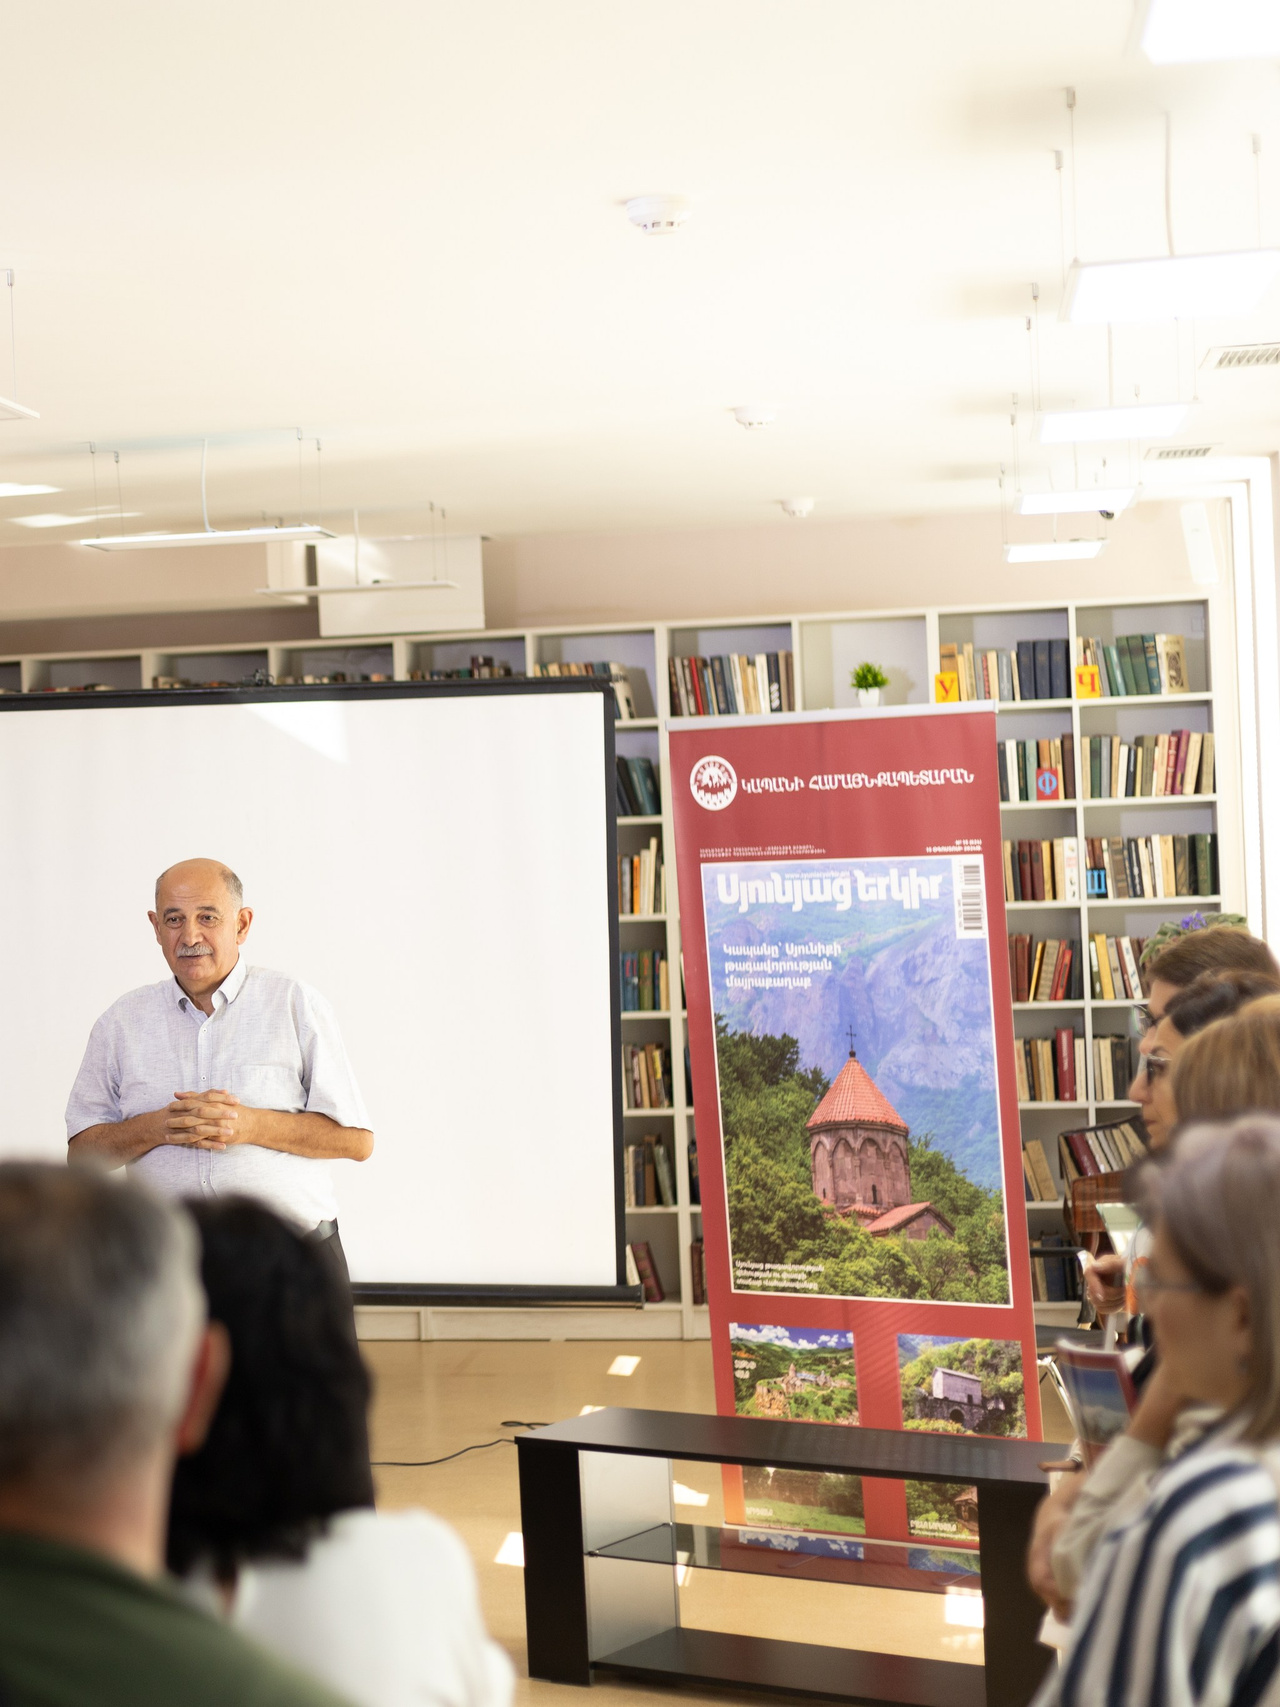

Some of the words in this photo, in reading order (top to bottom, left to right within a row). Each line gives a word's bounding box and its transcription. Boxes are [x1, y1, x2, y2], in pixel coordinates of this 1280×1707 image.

[938, 677, 956, 698] У
[1077, 672, 1097, 693] Ч
[741, 776, 805, 794] ԿԱՊԱՆԻ
[808, 768, 975, 792] ՀԱՄԱՅՆՔԱՊԵՏԱՐԱՆ
[1038, 771, 1057, 796] Ф
[717, 871, 853, 913] Սյունյաց
[785, 941, 842, 957] Սյունիքի
[724, 958, 833, 974] թագավորության
[725, 976, 812, 989] մայրաքաղաք
